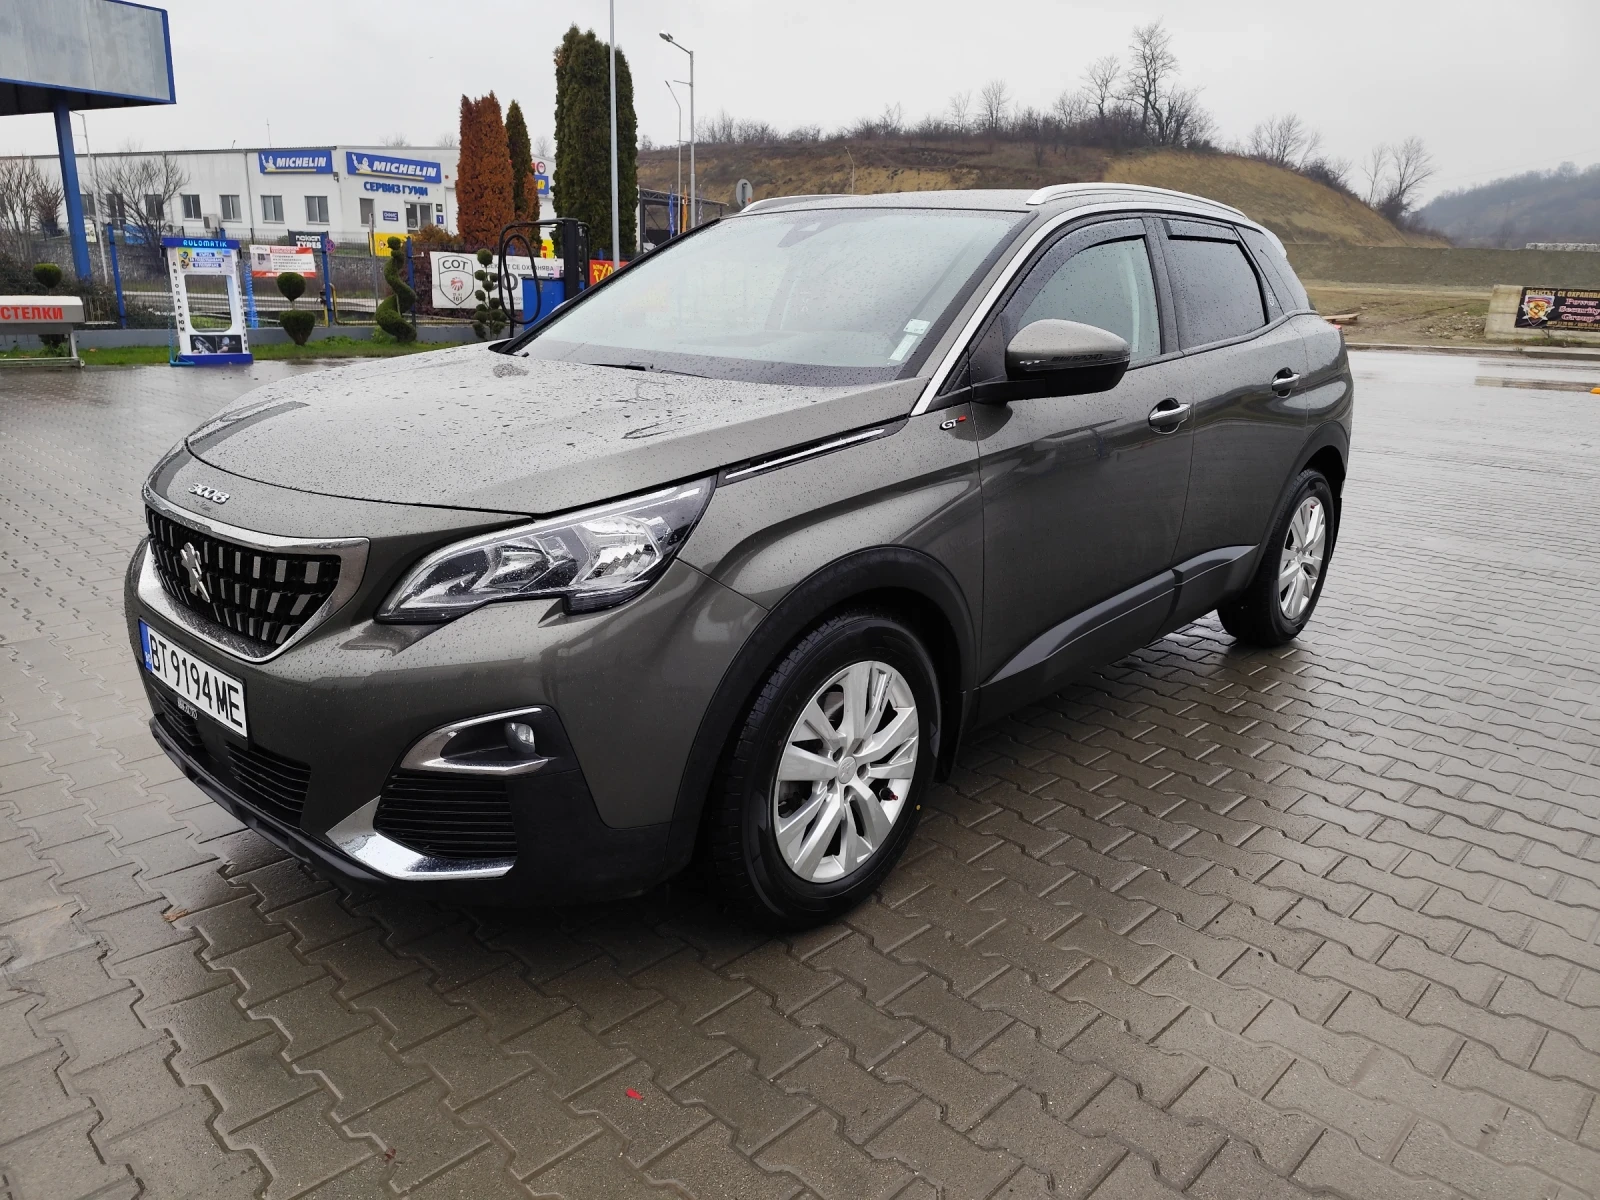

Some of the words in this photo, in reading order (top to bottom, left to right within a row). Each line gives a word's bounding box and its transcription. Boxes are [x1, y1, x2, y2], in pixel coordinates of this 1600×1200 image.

[276, 157, 327, 168] MICHELIN
[372, 161, 438, 177] MICHELIN
[364, 181, 401, 194] СЕРВИЗ
[402, 185, 428, 196] ГУМИ
[296, 241, 321, 249] TYRES
[0, 306, 63, 320] СТЕЛКИ
[940, 418, 958, 431] GT
[188, 482, 230, 504] 3008
[150, 634, 168, 679] BT
[171, 650, 212, 710] 9194
[214, 675, 243, 728] ME
